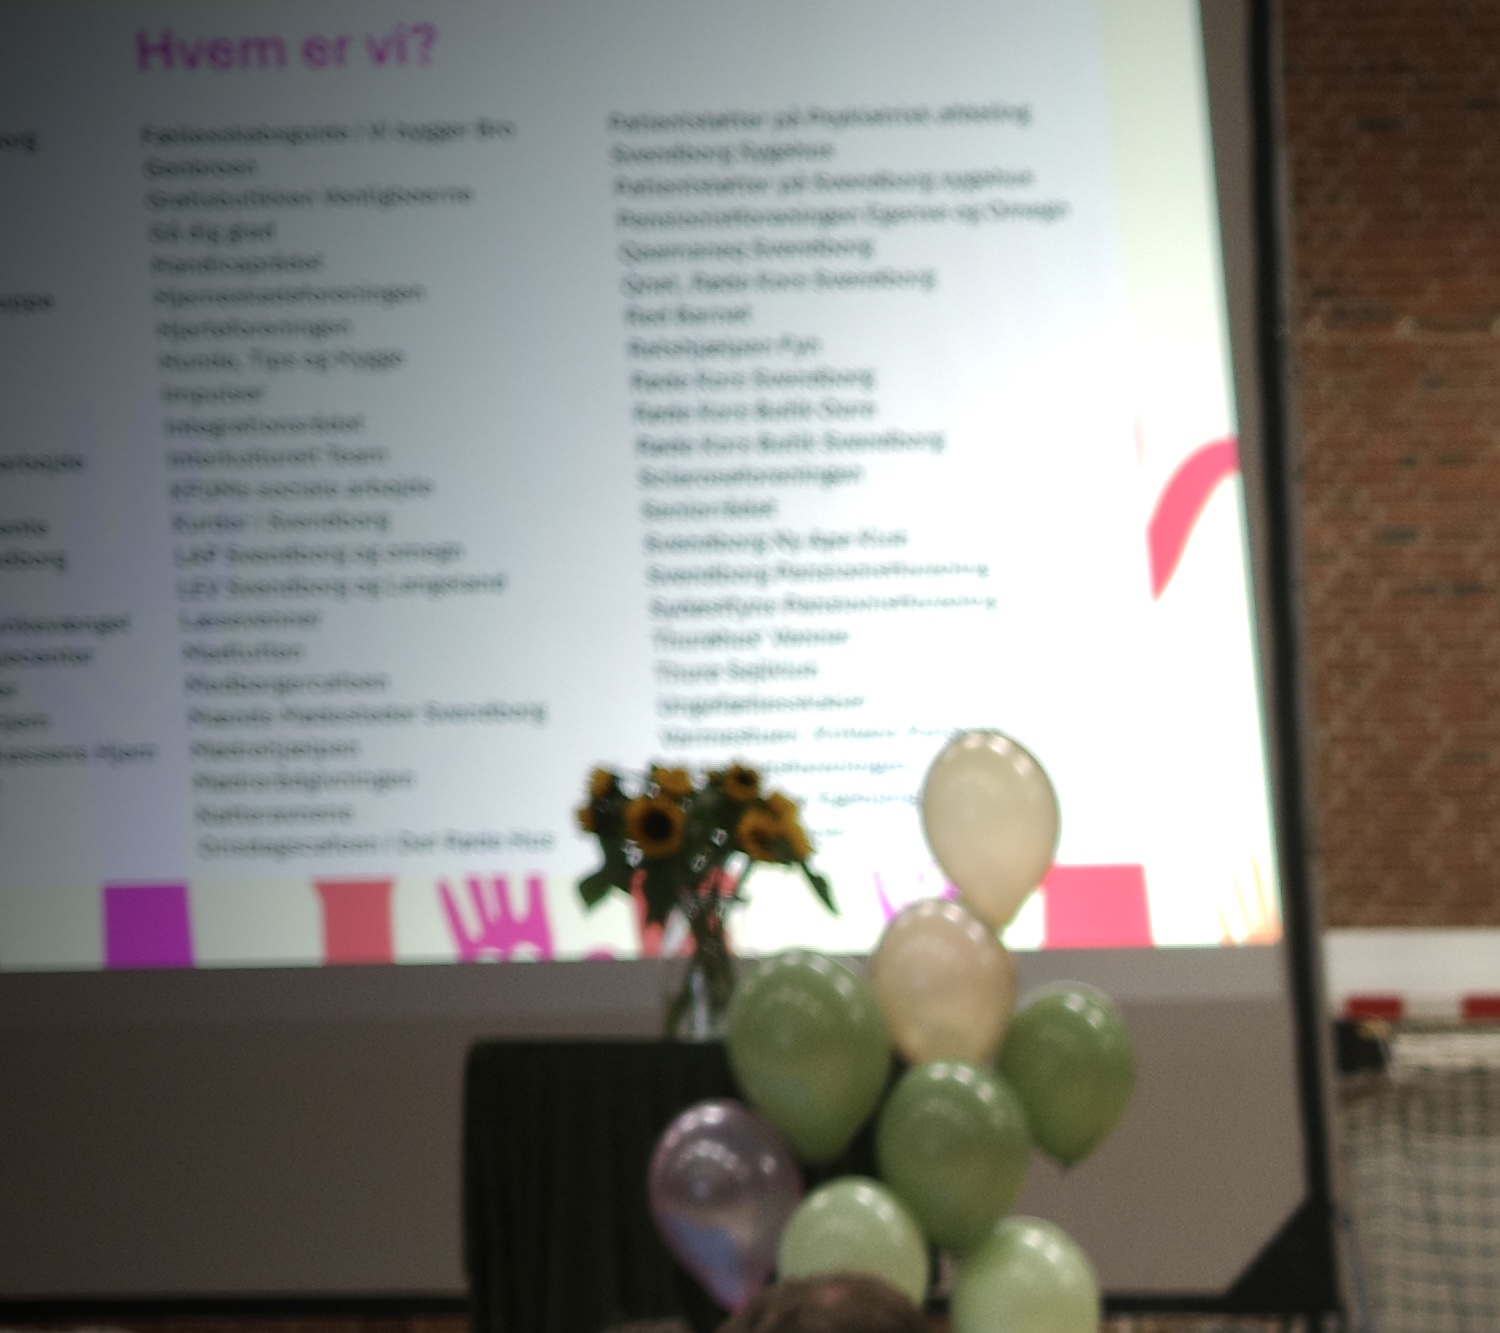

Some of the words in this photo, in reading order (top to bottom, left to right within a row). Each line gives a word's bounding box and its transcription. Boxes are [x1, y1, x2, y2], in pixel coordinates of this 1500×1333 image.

[135, 29, 286, 71] Hvem
[302, 34, 350, 67] er
[365, 21, 437, 66] vi?
